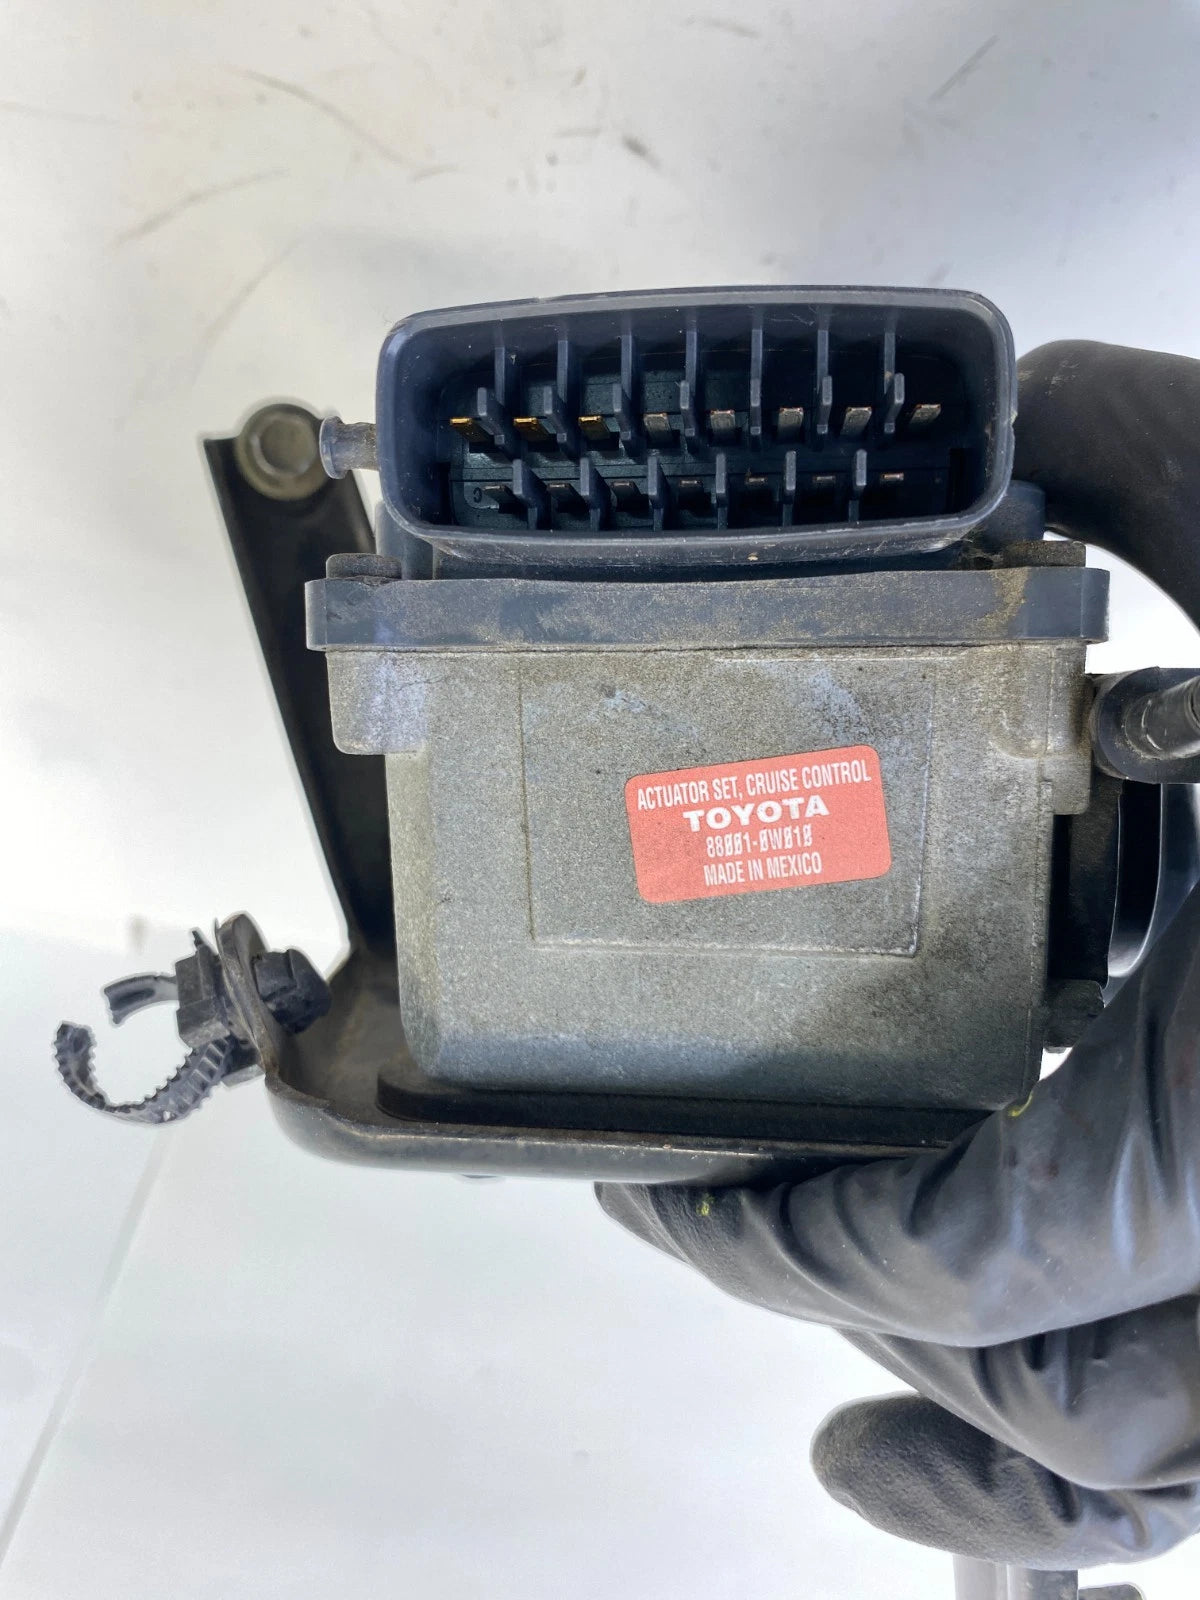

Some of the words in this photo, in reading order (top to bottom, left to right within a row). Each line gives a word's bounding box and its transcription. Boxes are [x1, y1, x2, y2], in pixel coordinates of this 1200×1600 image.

[637, 782, 709, 811] ACTUATOR
[712, 776, 743, 801] SET,
[745, 768, 798, 797] CRUISE
[801, 759, 872, 789] CONTROL
[682, 794, 830, 832] TOYOTA
[703, 862, 745, 886] MADE
[748, 858, 765, 881] IN
[766, 852, 823, 879] MEXICO
